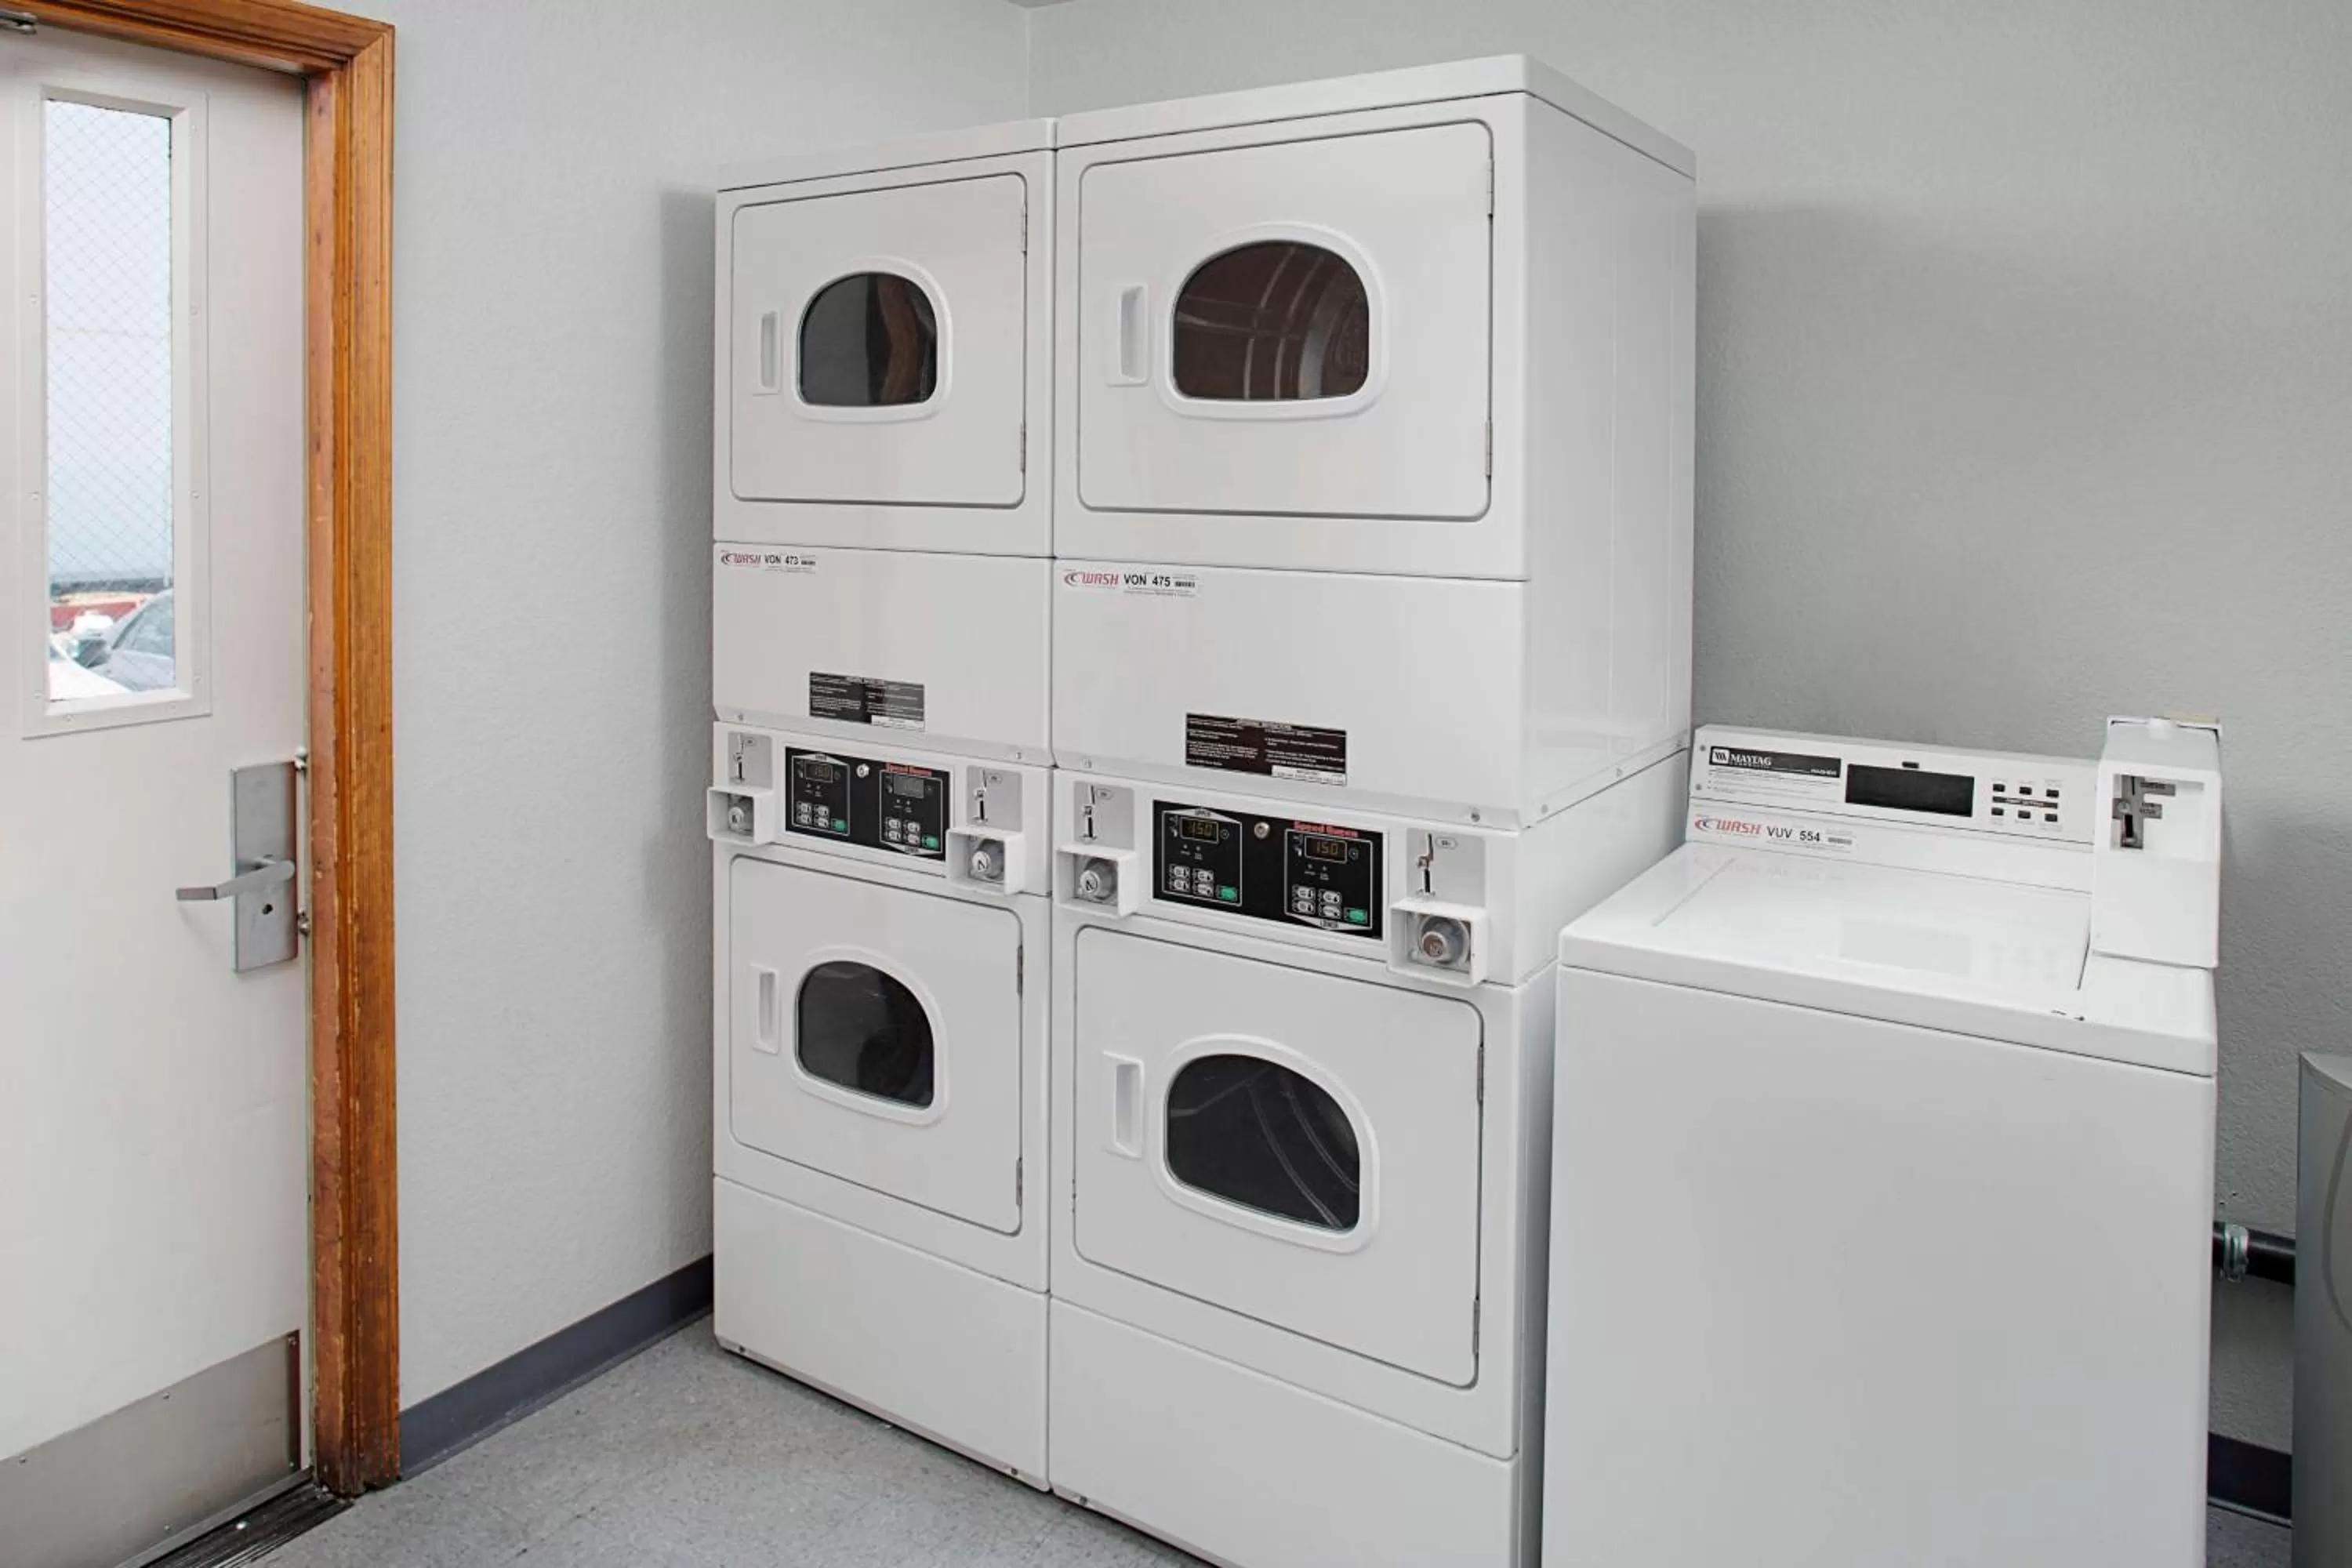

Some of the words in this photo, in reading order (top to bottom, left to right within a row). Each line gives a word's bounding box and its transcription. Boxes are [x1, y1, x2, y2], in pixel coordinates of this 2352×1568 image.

[1082, 573, 1119, 585] WASH
[1123, 574, 1147, 586] VON
[1152, 576, 1171, 587] 475
[1730, 753, 1772, 766] MAYTAG
[1716, 820, 1762, 835] WASH
[1766, 825, 1793, 839] VUV
[1799, 830, 1820, 842] 554
[1316, 840, 1338, 855] 150
